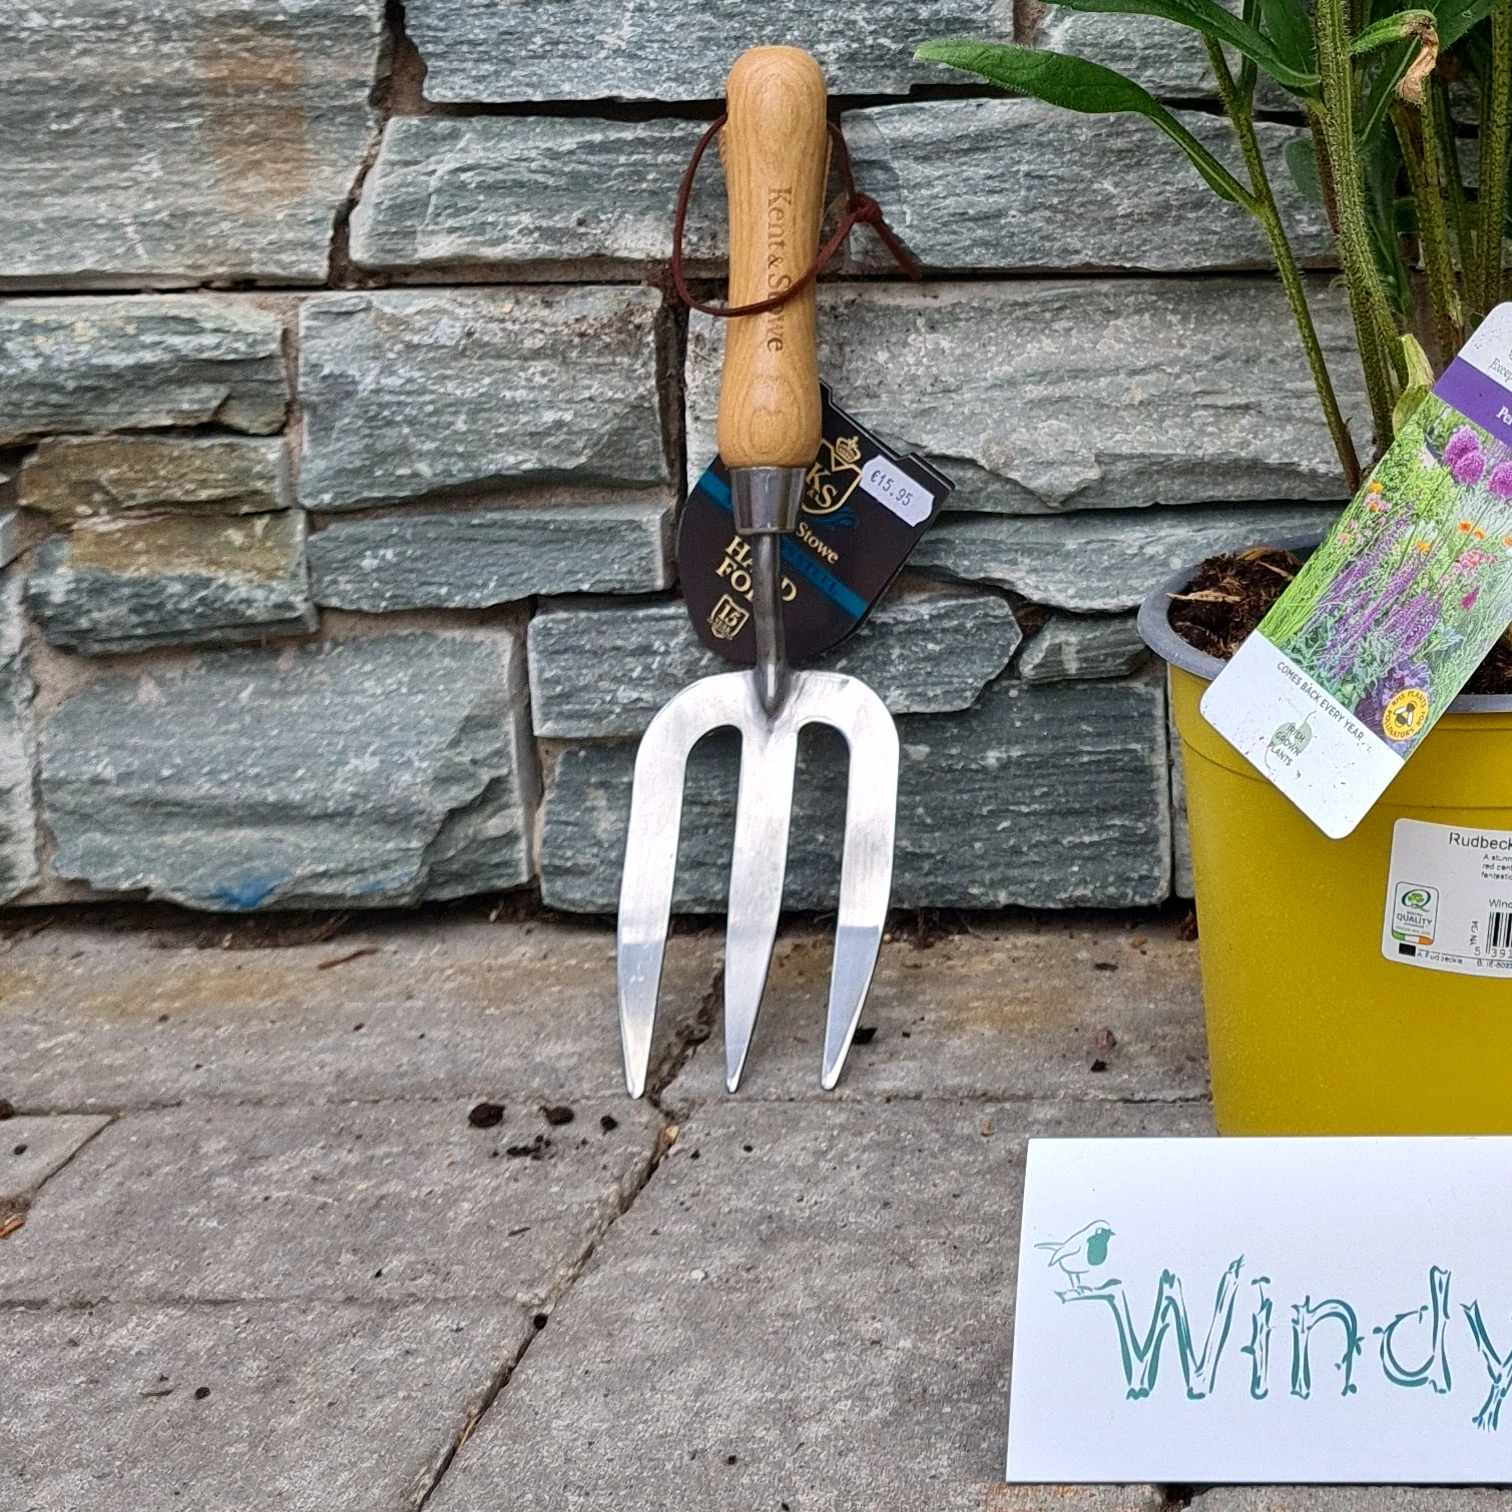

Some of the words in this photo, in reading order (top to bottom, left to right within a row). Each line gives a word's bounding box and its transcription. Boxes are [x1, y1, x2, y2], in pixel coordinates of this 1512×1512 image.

[768, 187, 792, 249] Kent
[768, 254, 784, 268] &
[871, 470, 913, 506] €15.95
[796, 522, 839, 564] Stowe
[718, 603, 741, 627] 15
[1277, 662, 1302, 686] COMES
[1300, 682, 1322, 703] BACK
[1319, 699, 1345, 722] EVERY
[1343, 719, 1365, 741] YEAR
[1275, 731, 1301, 757] GROWN
[1287, 724, 1306, 743] IRISH
[1267, 741, 1293, 767] PLANTS
[1397, 913, 1433, 926] QUALITY
[1474, 946, 1481, 956] 5
